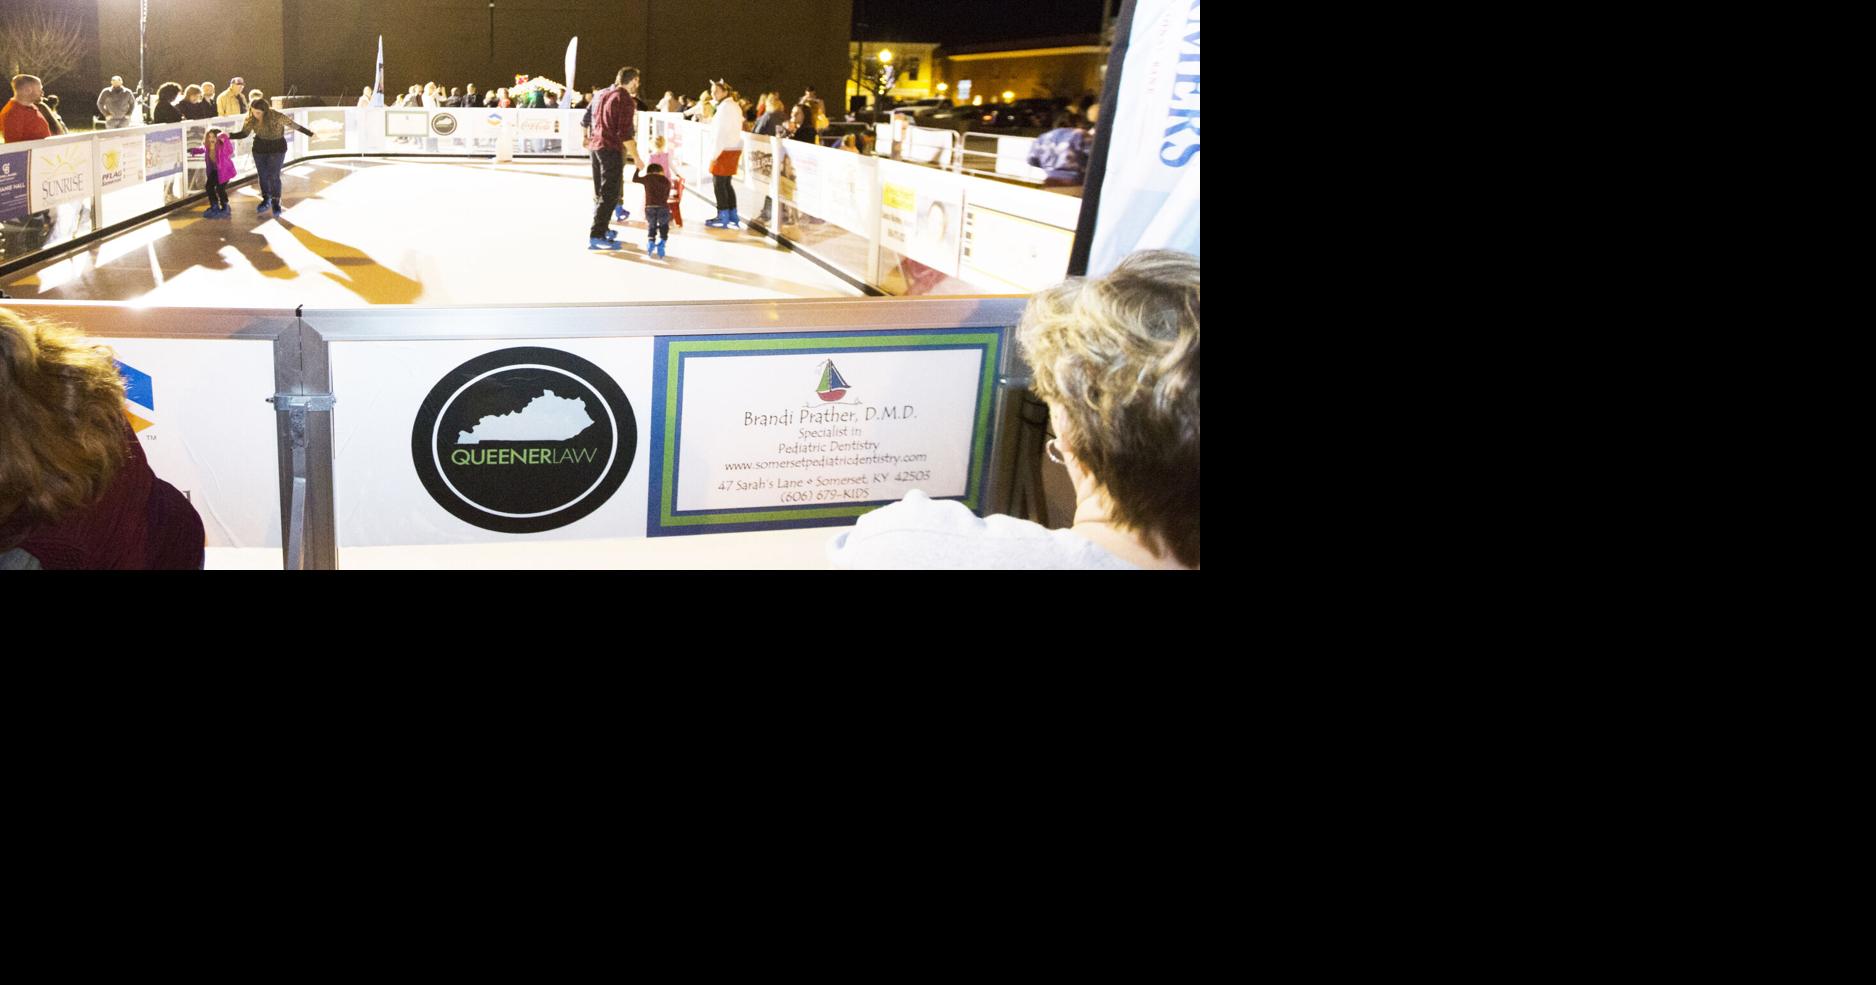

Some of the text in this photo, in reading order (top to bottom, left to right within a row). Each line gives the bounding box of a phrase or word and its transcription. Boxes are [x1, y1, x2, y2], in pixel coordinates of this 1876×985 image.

[1158, 0, 1200, 168] MERS
[102, 170, 122, 181] PFLAG
[42, 173, 84, 200] SUNRISE
[743, 405, 919, 426] Brandi Prather, D.M.D.
[798, 425, 862, 439] Specialist in
[778, 438, 881, 454] Pediatric Dentistry
[724, 453, 928, 472] www.somersetpediatricdentistry.com
[717, 479, 734, 492] 47
[735, 477, 774, 491] Sarah's
[776, 475, 804, 489] Lane
[872, 472, 890, 483] KY
[894, 470, 931, 482] 42503
[780, 488, 871, 504] (606) 679-KIDS
